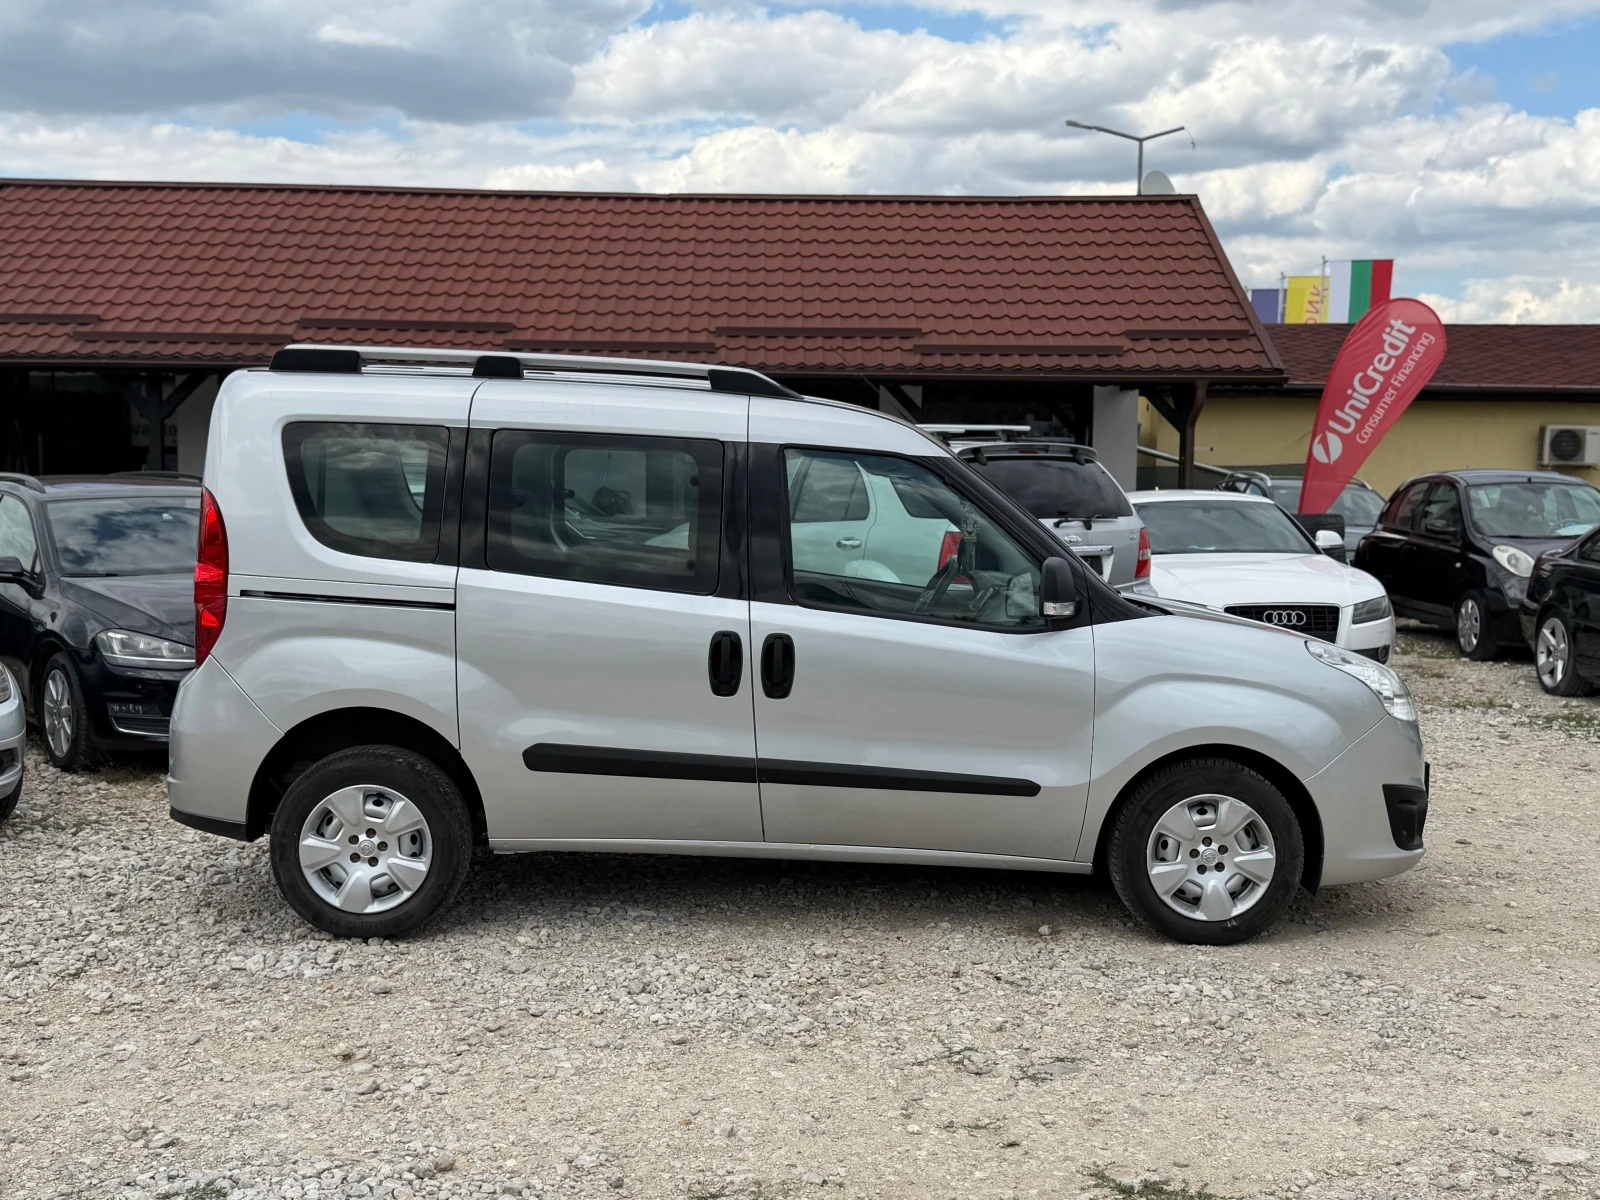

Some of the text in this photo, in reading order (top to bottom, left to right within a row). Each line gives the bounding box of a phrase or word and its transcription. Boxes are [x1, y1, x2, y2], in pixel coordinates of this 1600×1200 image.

[1328, 319, 1416, 434] UniCredit
[1356, 332, 1435, 444] Consumer Financing
